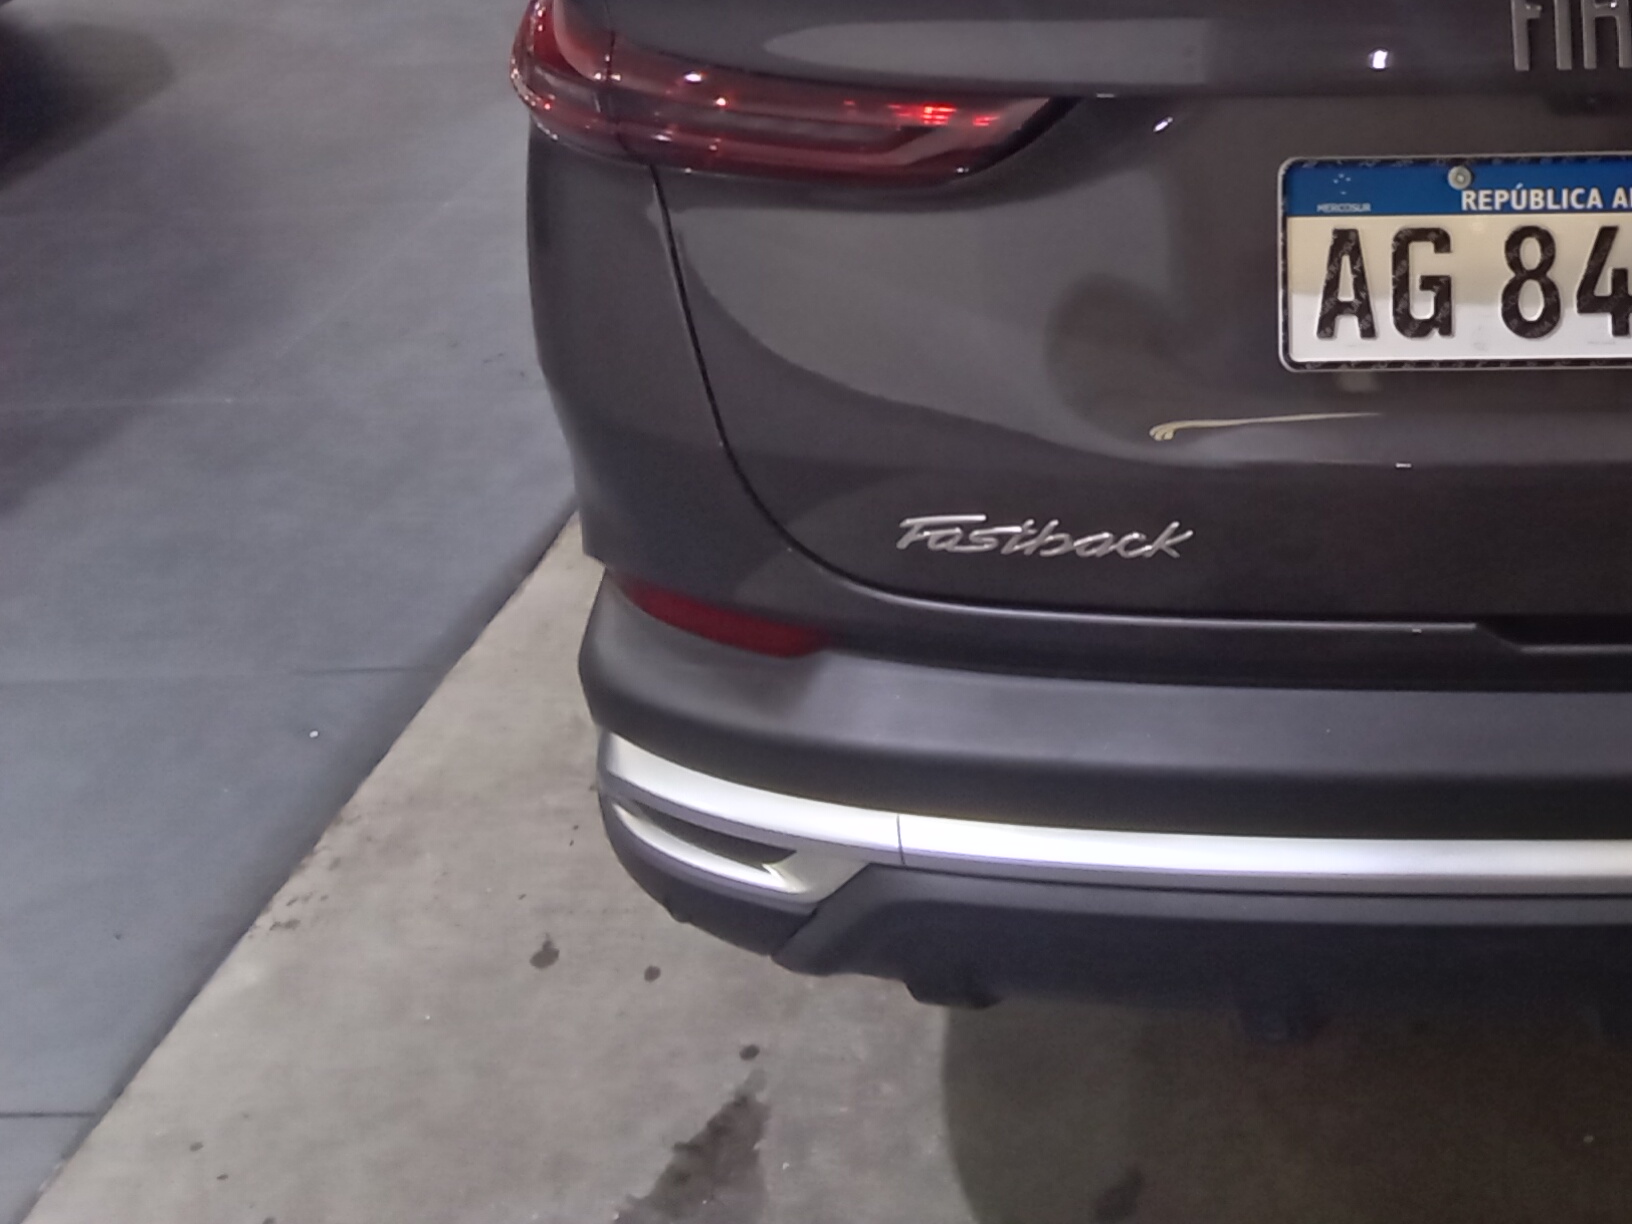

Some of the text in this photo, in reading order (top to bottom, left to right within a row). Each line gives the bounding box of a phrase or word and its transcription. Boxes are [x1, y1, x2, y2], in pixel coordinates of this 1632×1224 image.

[1316, 202, 1372, 214] MERCOSUR
[1461, 183, 1603, 211] REPÚBLICA
[1316, 227, 1453, 339] AG
[896, 514, 1194, 559] Fastback
